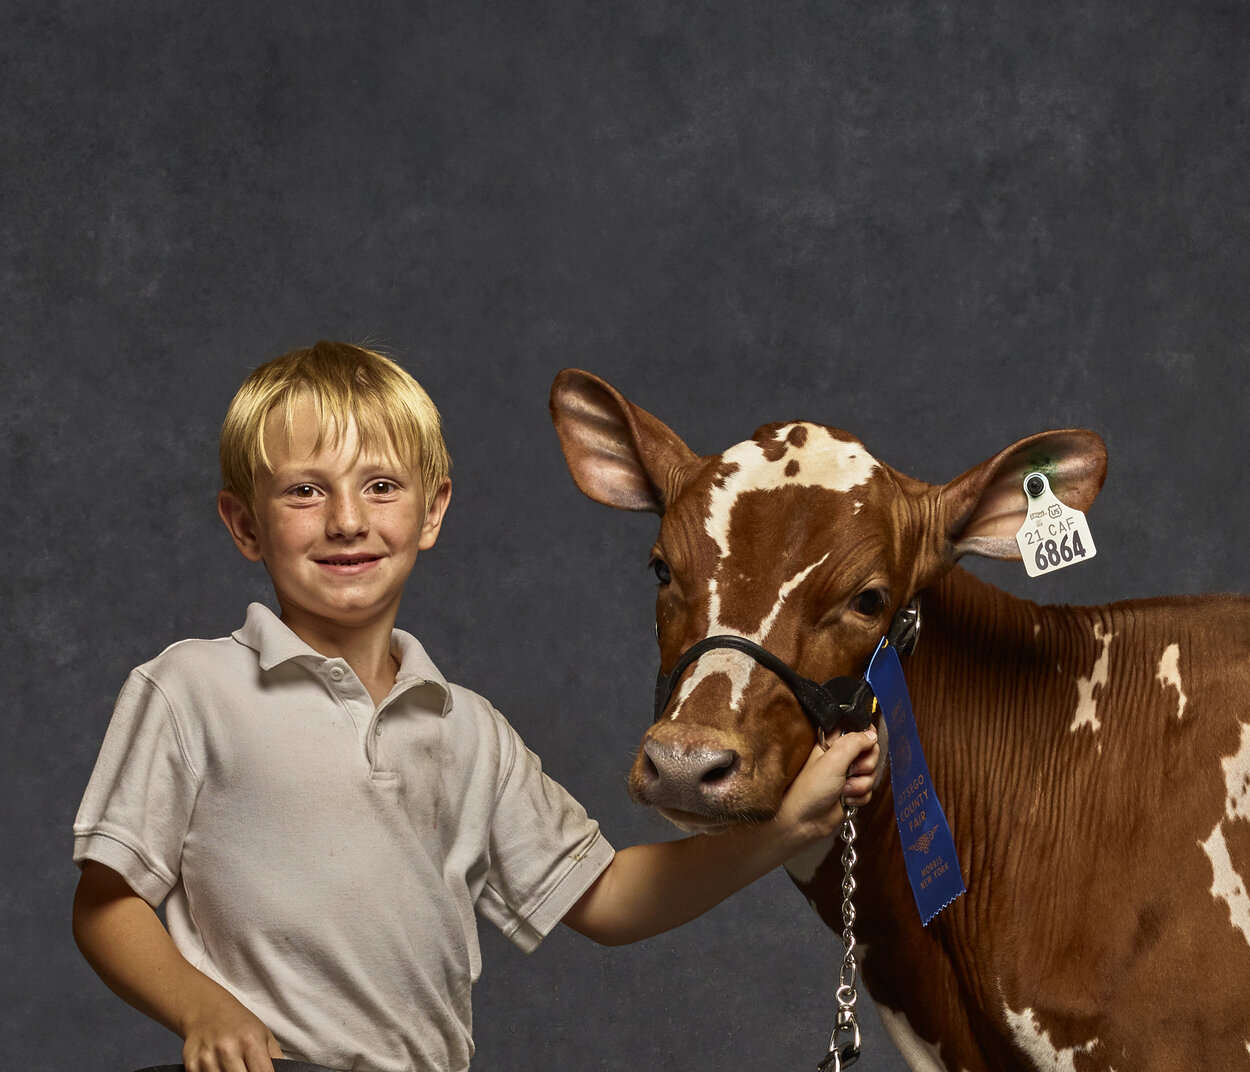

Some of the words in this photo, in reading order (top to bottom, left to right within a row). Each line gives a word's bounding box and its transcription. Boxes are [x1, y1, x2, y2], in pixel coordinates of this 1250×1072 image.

[1051, 508, 1060, 516] US
[1025, 529, 1044, 545] 21
[1048, 516, 1075, 536] CAF
[1035, 529, 1086, 570] 6864
[898, 774, 924, 806] OTSEGO
[900, 788, 928, 822] COUNTY
[909, 810, 927, 832] FAIR
[920, 874, 932, 889] NEW
[933, 861, 949, 879] YORK
